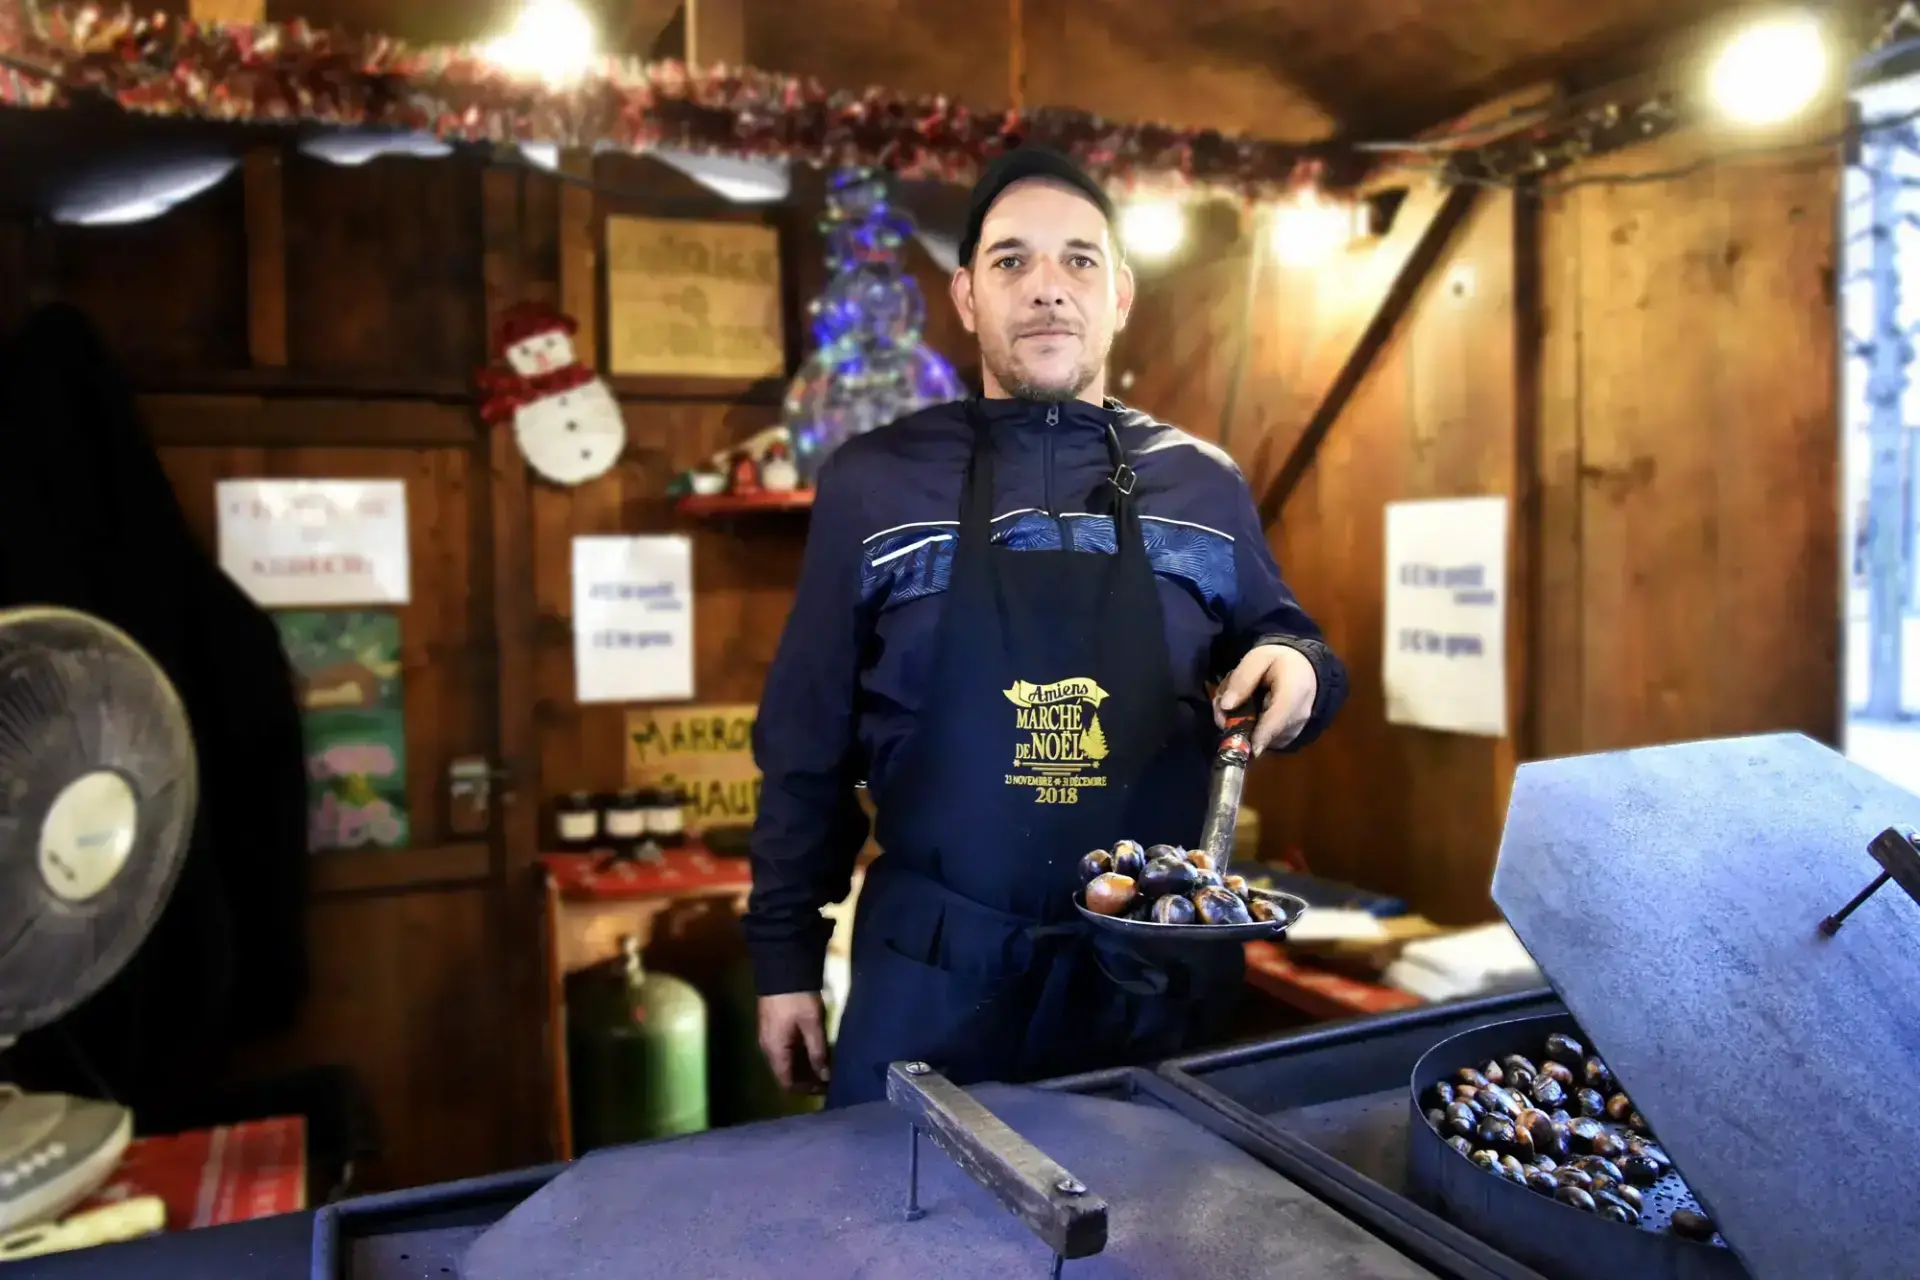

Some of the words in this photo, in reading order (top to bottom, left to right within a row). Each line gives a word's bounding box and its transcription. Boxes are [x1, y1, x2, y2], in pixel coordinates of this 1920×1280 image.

[1028, 683, 1088, 702] Amiens
[1016, 698, 1083, 731] MARCHÉ
[632, 716, 756, 763] MARRO
[1015, 743, 1031, 759] DE
[1031, 731, 1083, 760] NOËL
[1013, 775, 1053, 787] NOVEMBRE
[1070, 774, 1107, 787] DÉCEMBRE
[1035, 787, 1078, 804] 2018
